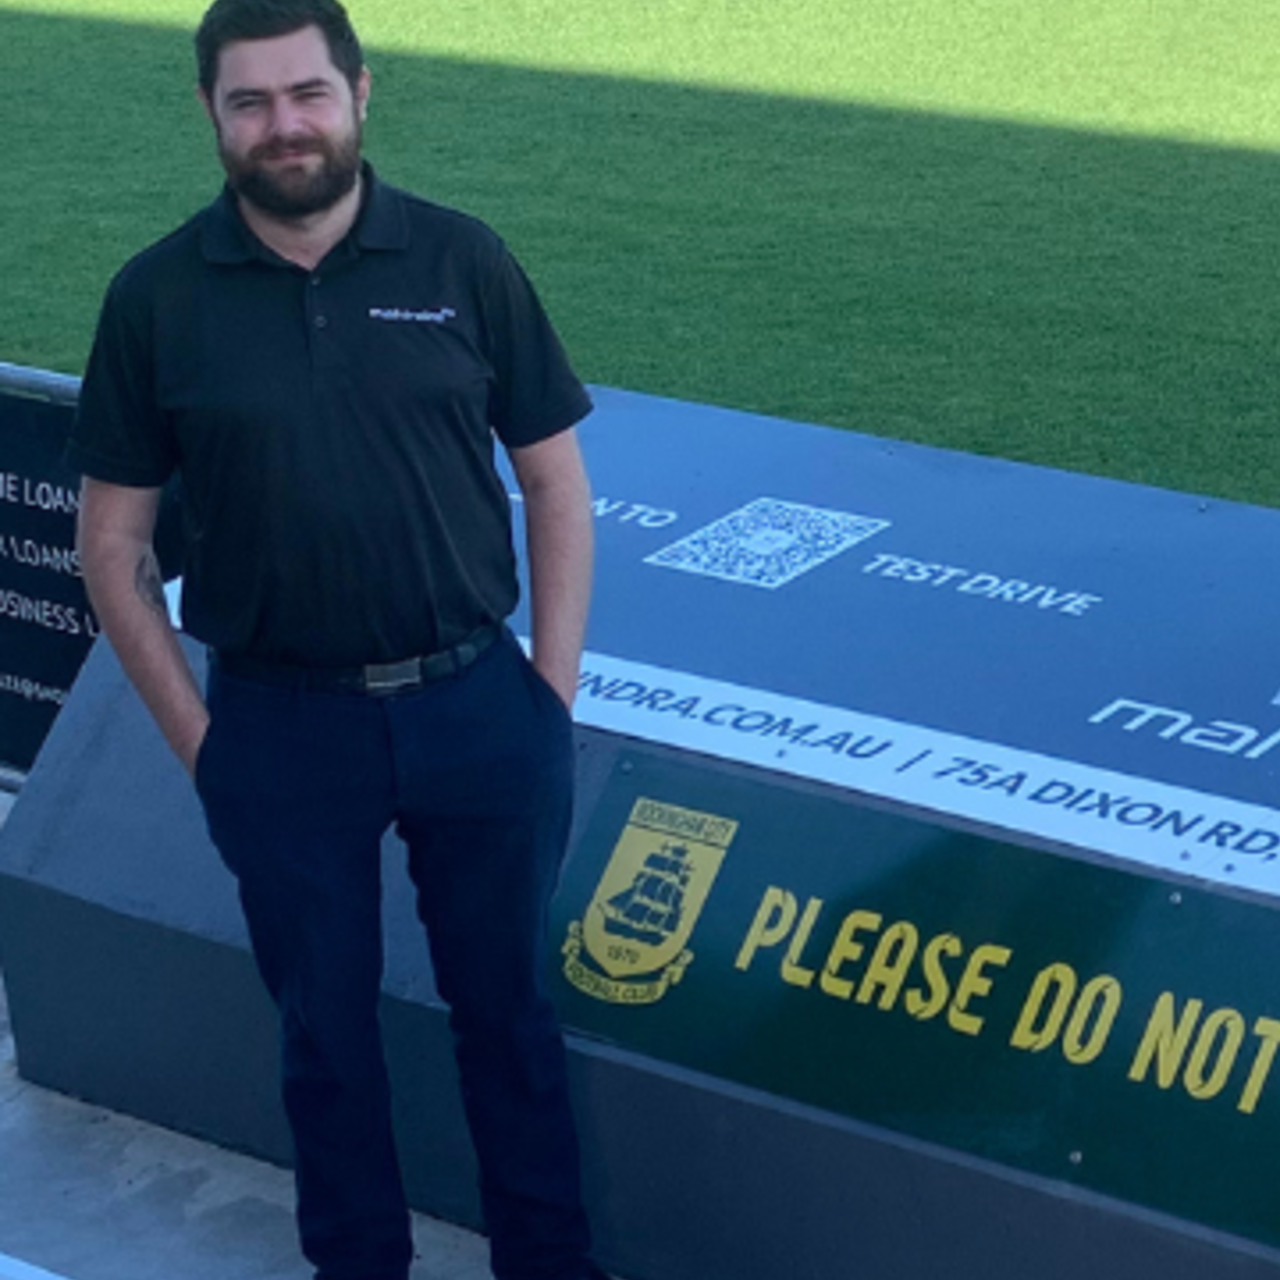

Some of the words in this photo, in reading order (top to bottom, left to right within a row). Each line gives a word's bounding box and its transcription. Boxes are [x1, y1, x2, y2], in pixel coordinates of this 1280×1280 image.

[619, 503, 678, 528] TO
[862, 553, 969, 587] TEST
[955, 572, 1103, 617] DRIVE
[932, 756, 1028, 797] 75A
[1027, 778, 1206, 838] DIXON
[735, 886, 1012, 1036] PLEASE
[1008, 962, 1122, 1066] DO
